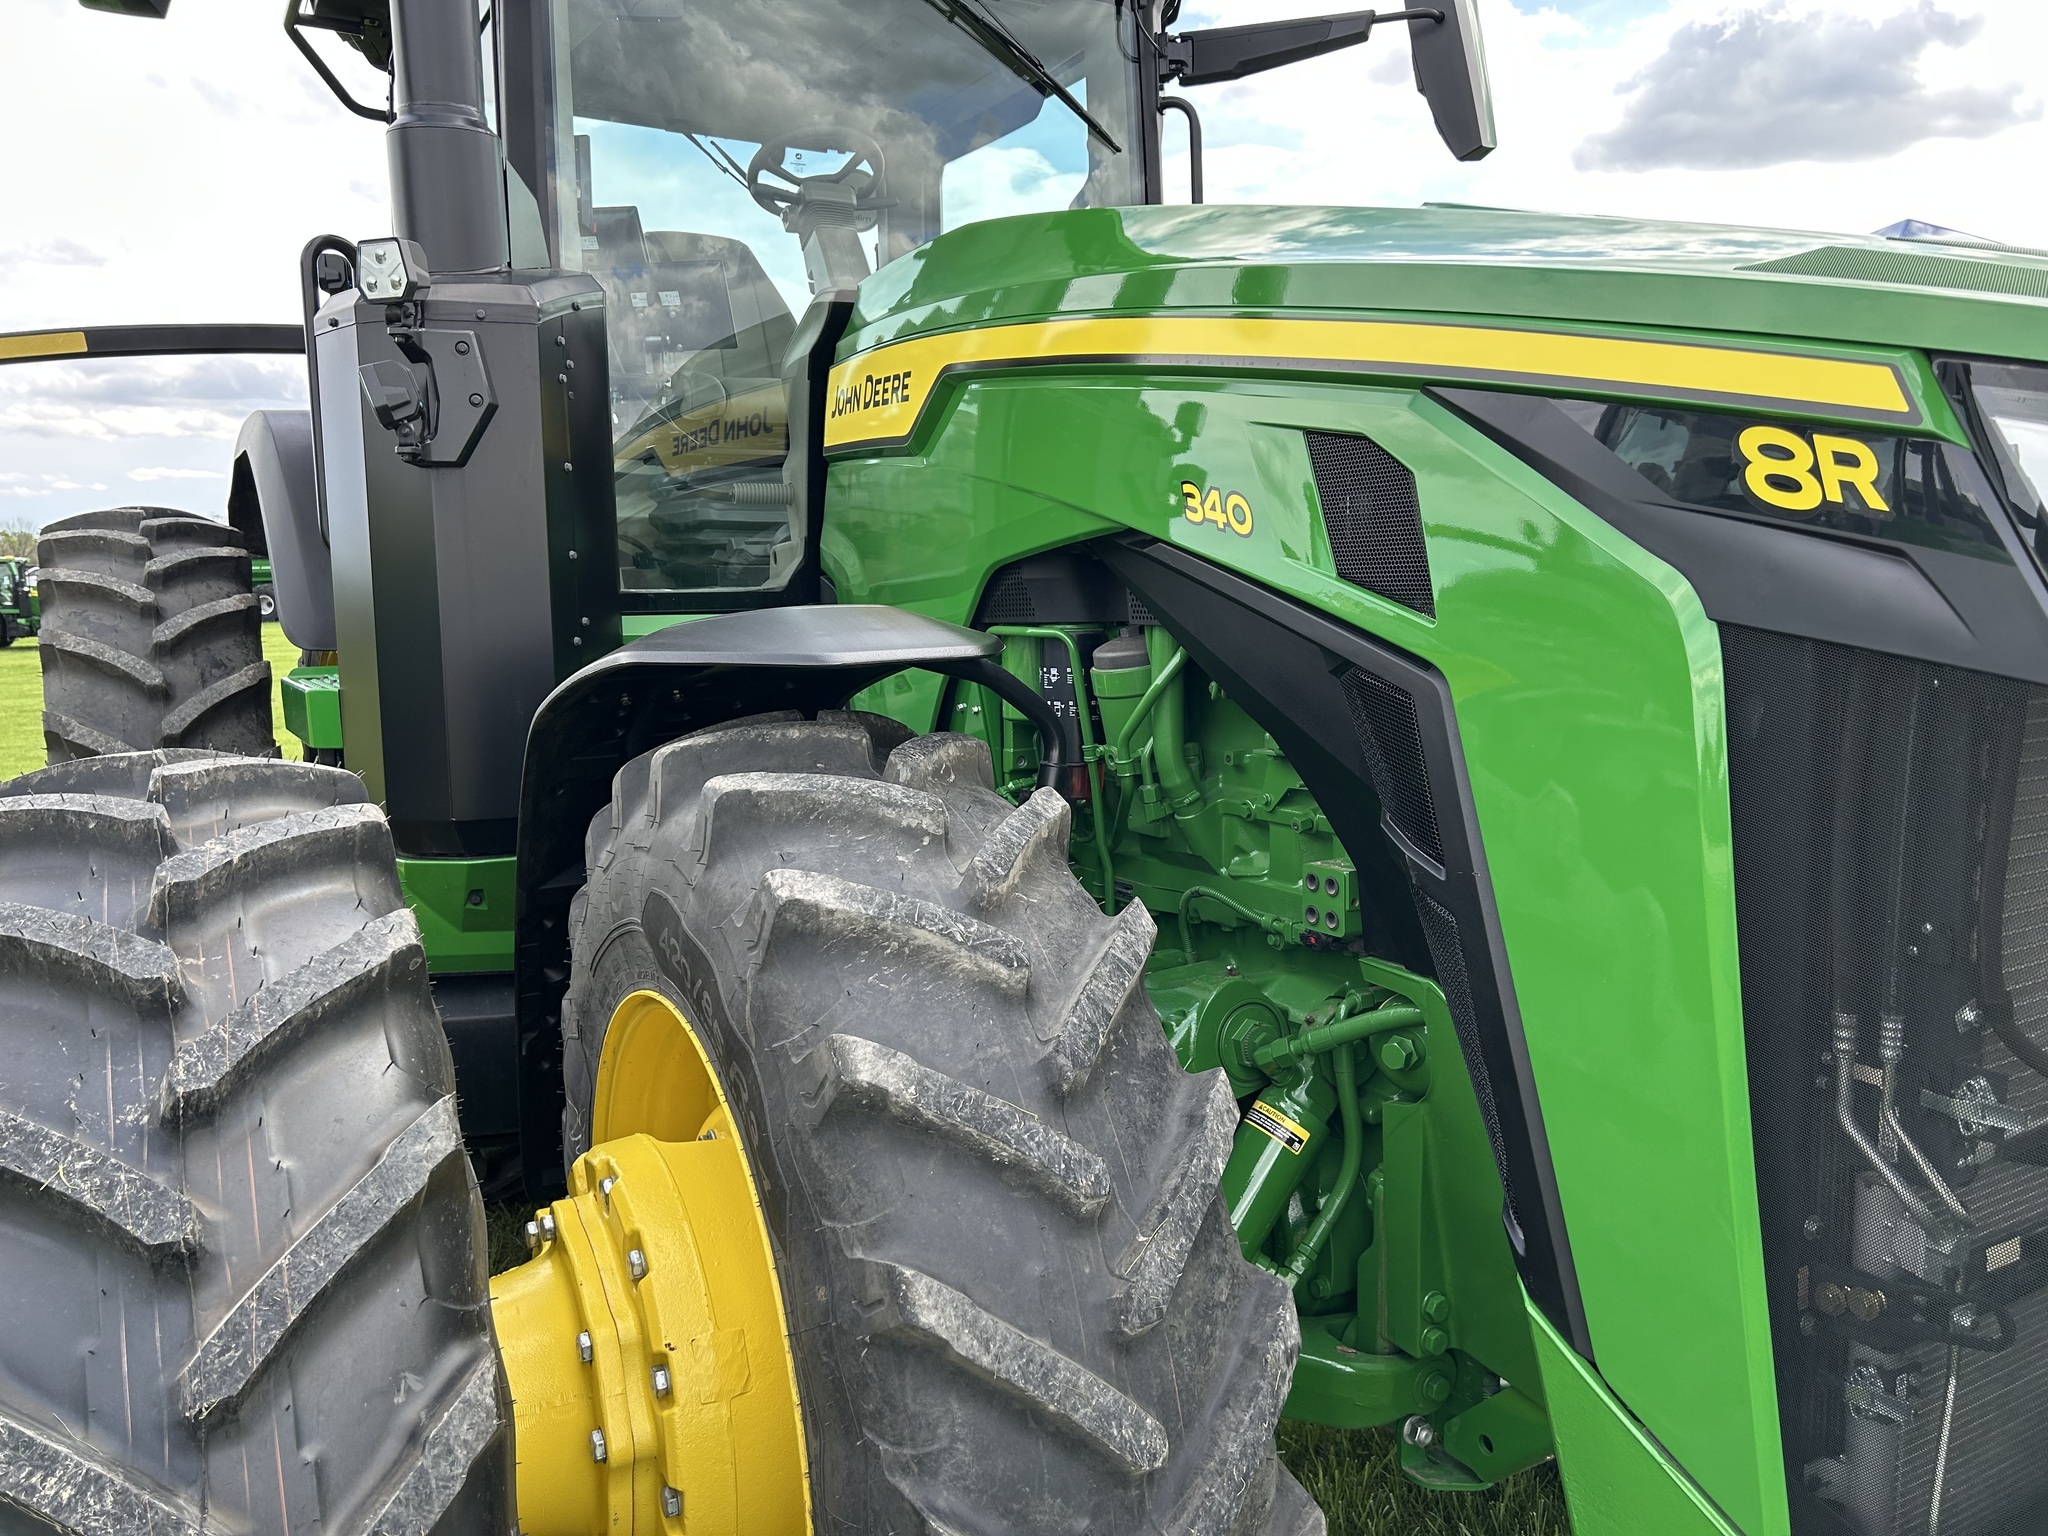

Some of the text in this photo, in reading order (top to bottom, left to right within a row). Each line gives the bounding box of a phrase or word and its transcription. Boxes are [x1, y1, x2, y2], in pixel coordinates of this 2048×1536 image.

[831, 370, 912, 419] JOHN DEERE
[1738, 425, 1890, 512] 8R
[1181, 481, 1253, 537] 340
[1262, 1104, 1287, 1124] CAUTION
